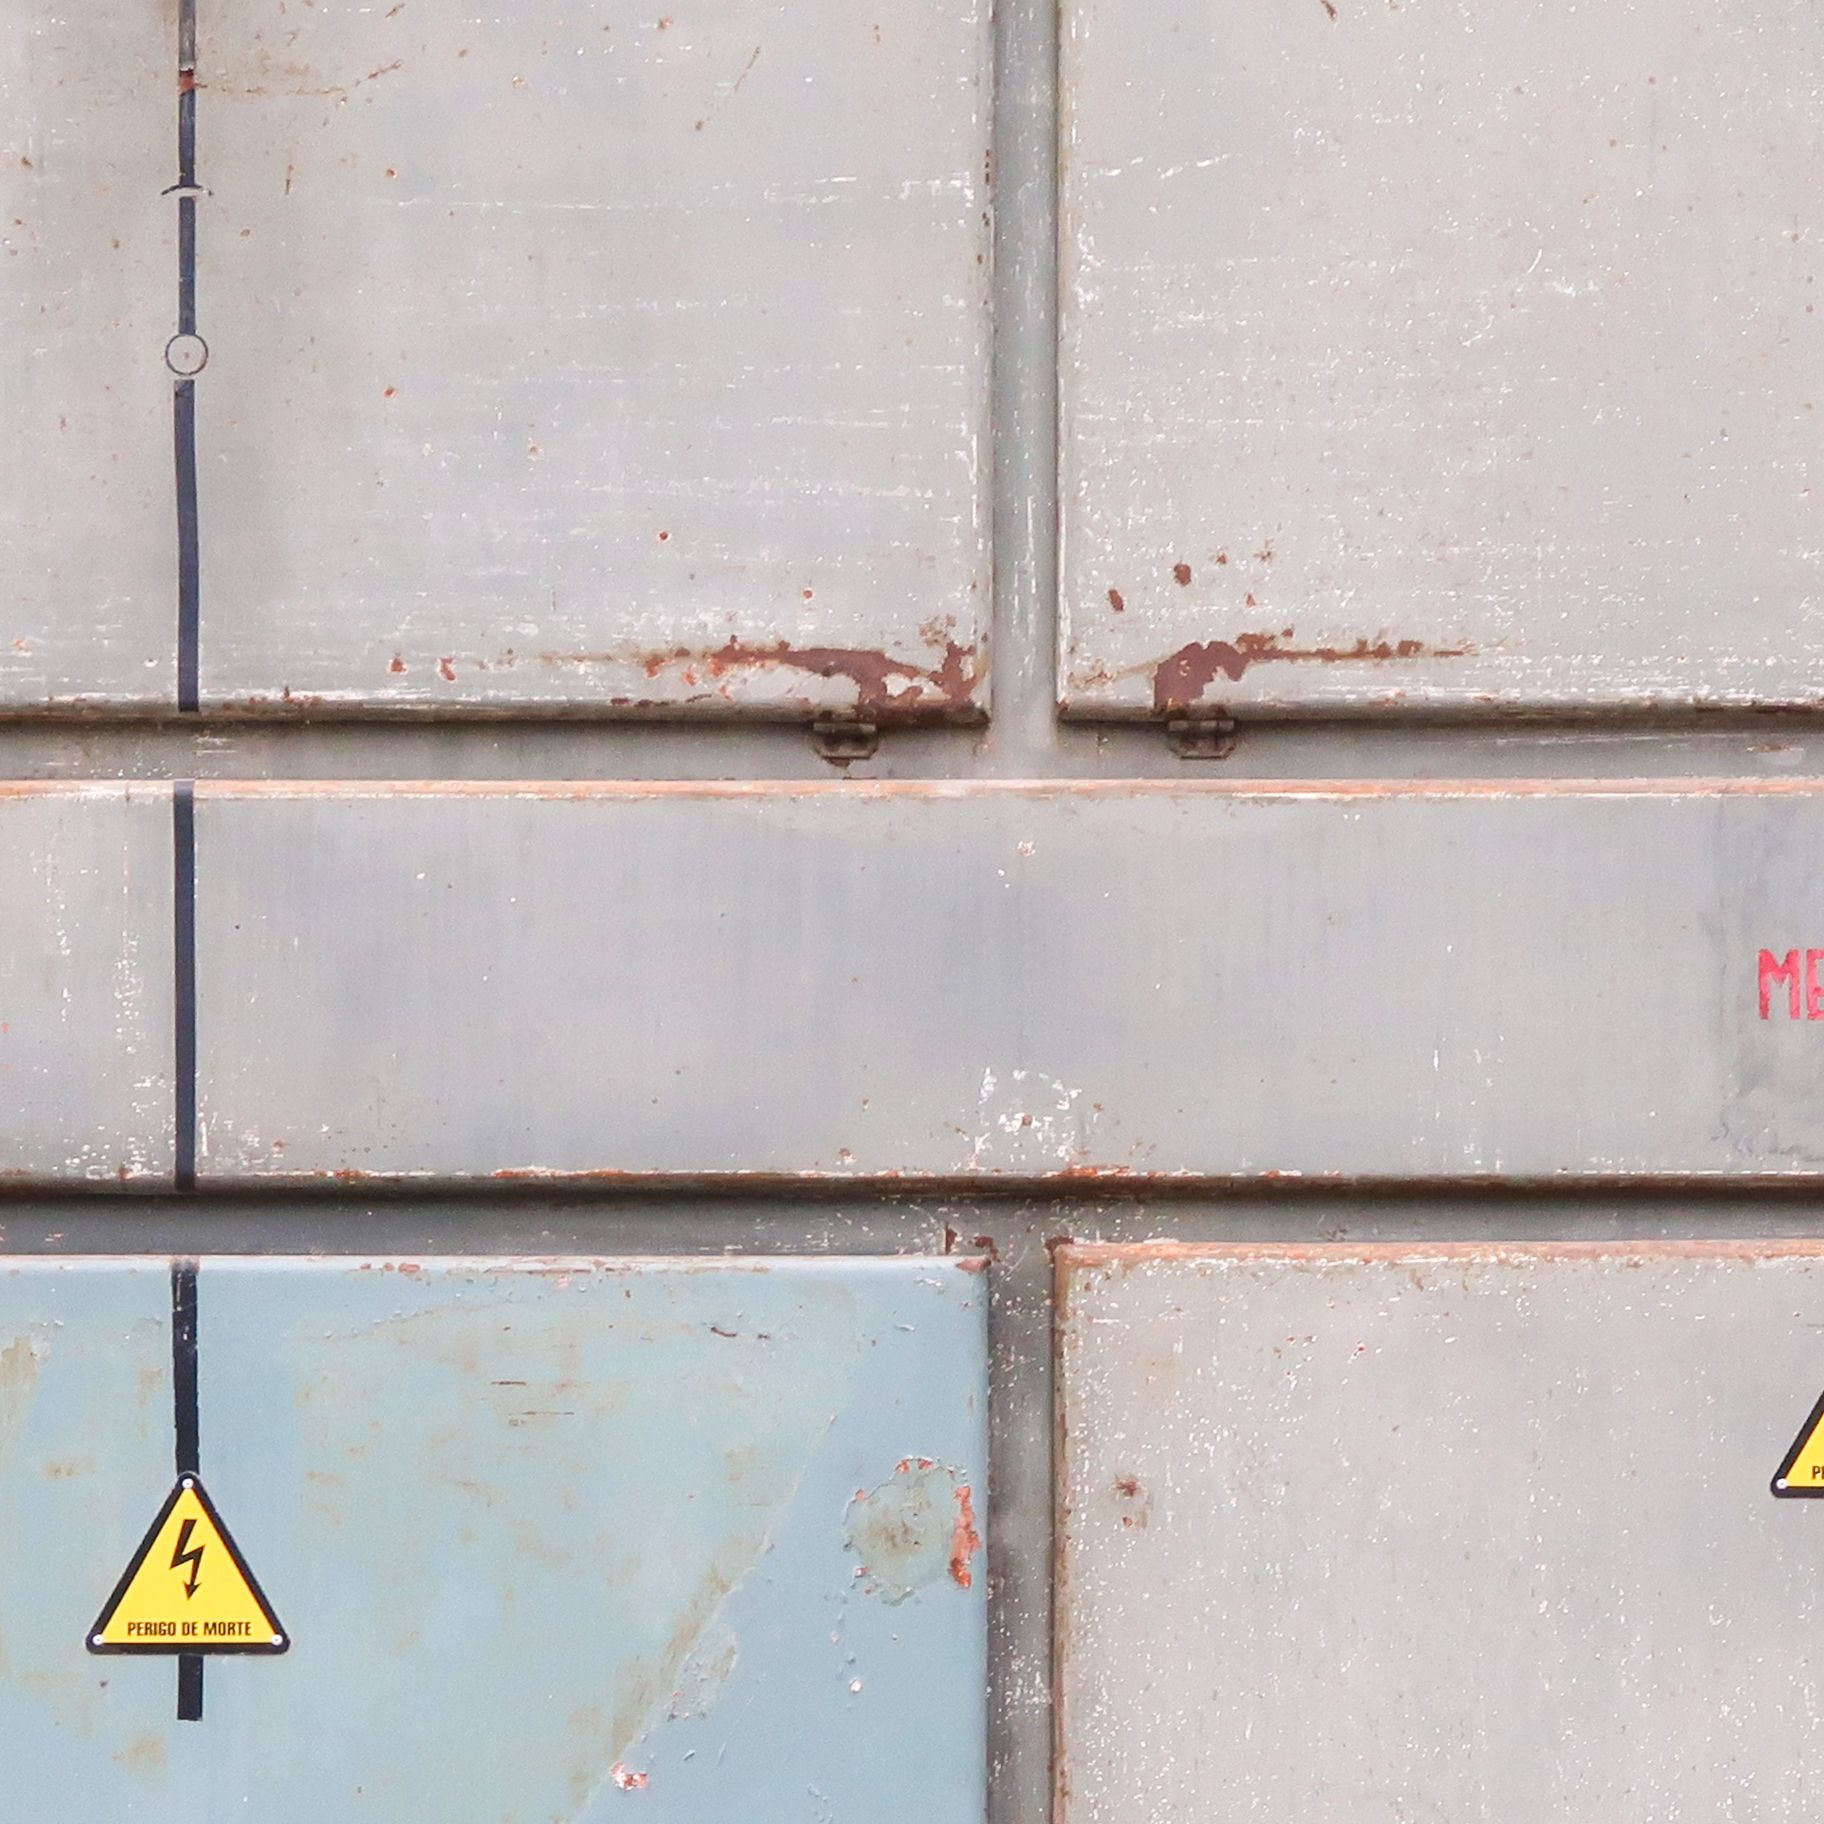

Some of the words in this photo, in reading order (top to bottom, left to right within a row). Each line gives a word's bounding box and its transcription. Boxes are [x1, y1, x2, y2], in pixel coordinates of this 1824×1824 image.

[127, 1621, 176, 1637] PERIGO
[181, 1621, 198, 1637] DE
[203, 1621, 252, 1637] MORTE
